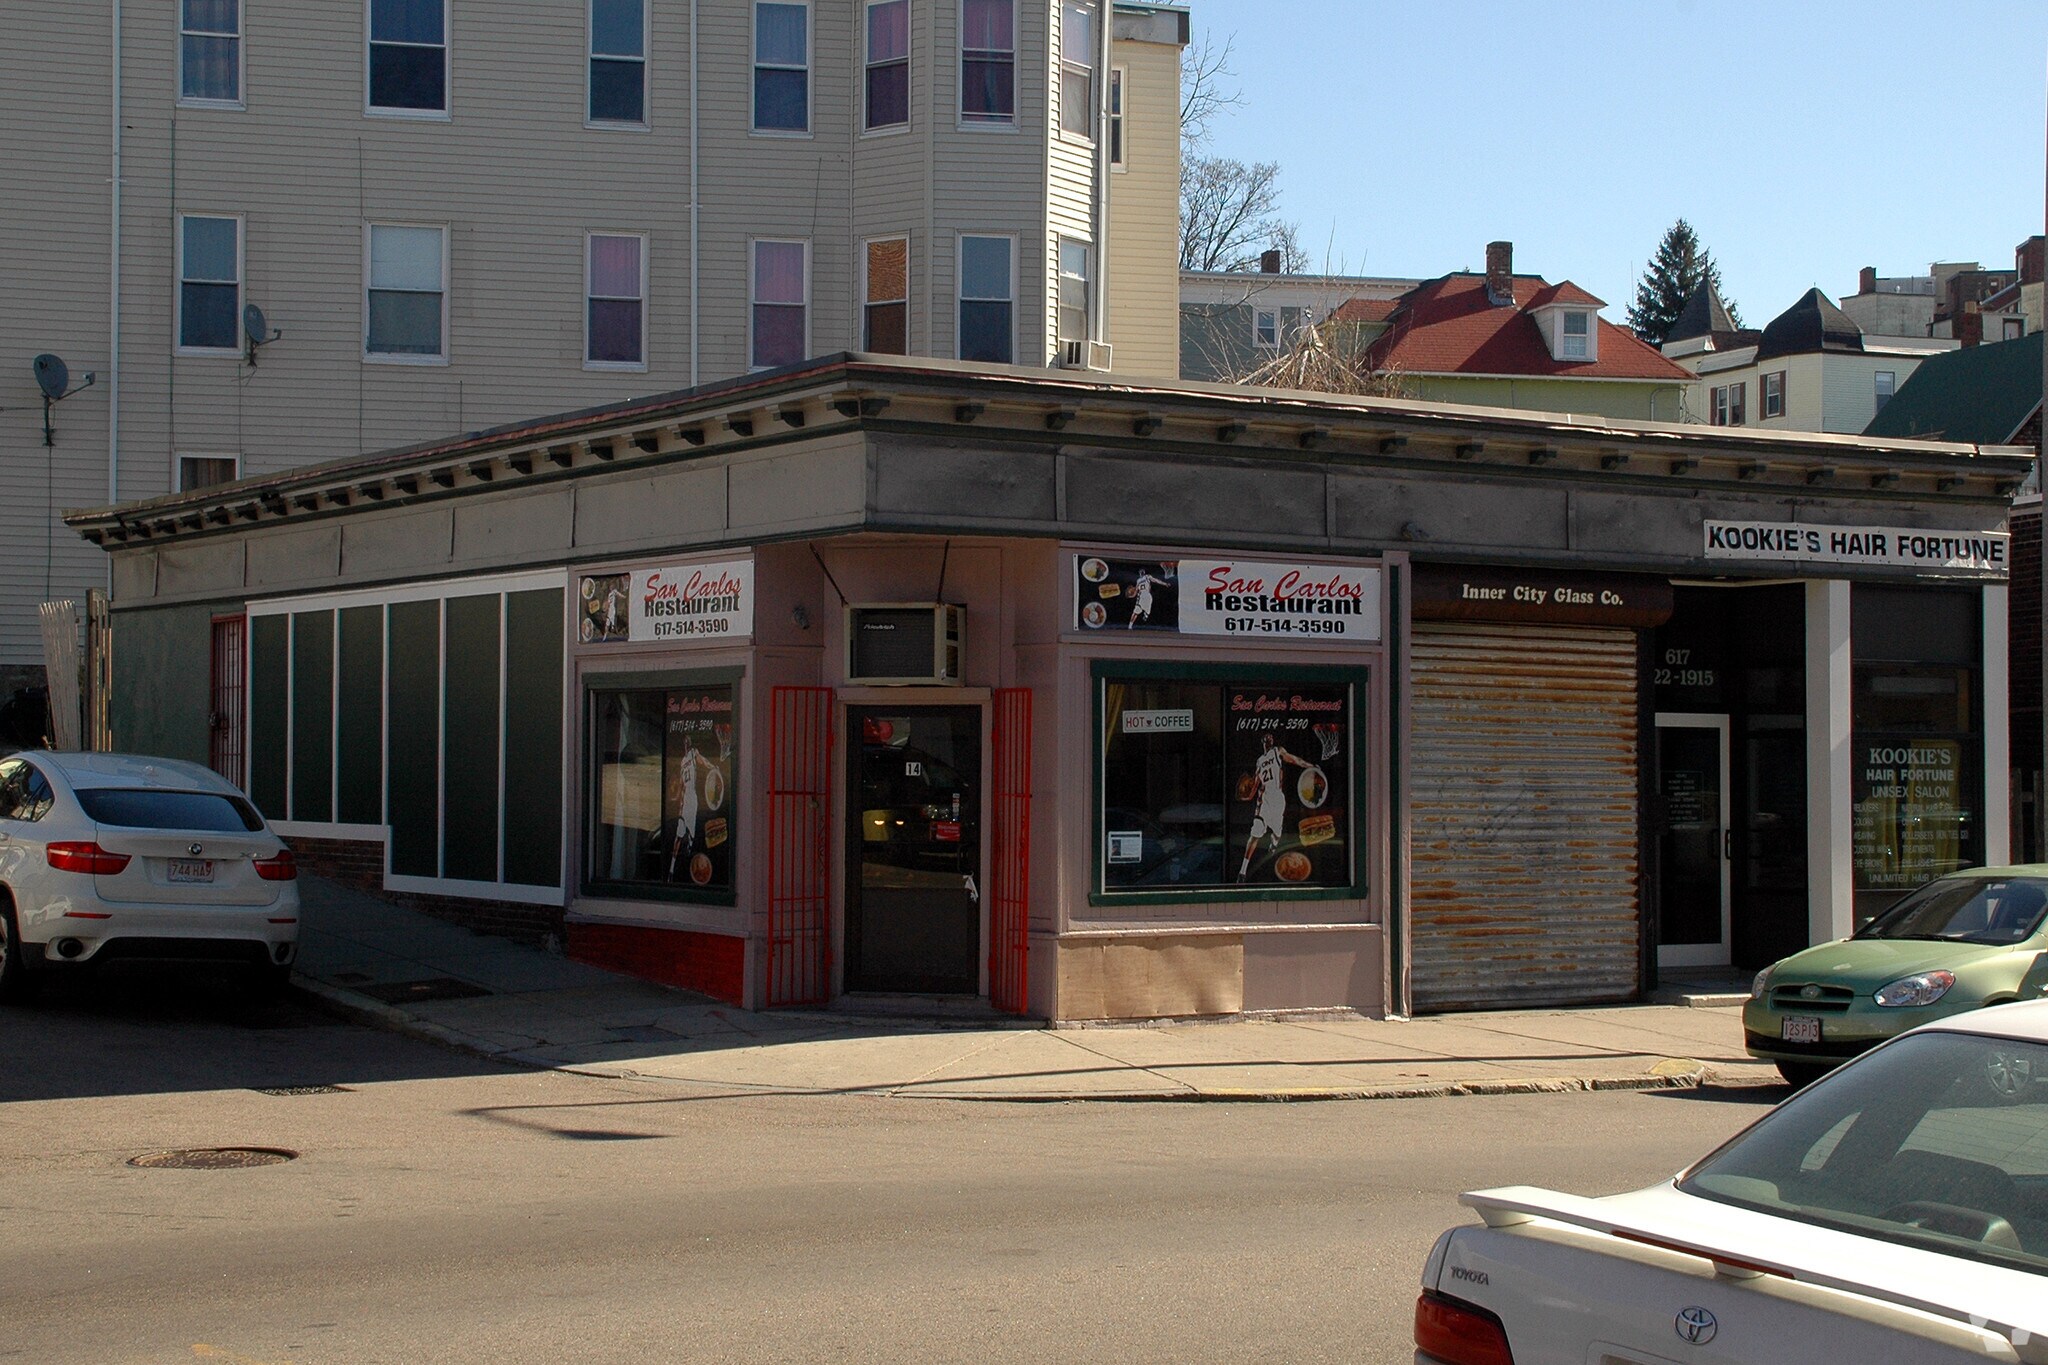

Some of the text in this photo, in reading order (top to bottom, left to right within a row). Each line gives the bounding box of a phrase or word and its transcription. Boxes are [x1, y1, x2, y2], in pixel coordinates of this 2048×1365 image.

[1708, 526, 2004, 562] KOOKIE'S HAIR FORTUNE
[644, 570, 742, 603] San Carlos
[1204, 566, 1365, 601] San Carlos
[1462, 583, 1624, 606] Inner City Glass Co.
[644, 593, 741, 618] Restaurant
[1204, 592, 1363, 616] Restaurant
[654, 617, 730, 636] 617-514-3590
[1224, 617, 1346, 635] 617-514-3590
[1665, 648, 1691, 665] 617
[1653, 668, 1714, 686] 22-1915
[1231, 694, 1344, 713] San Carlos Restaurant
[1125, 715, 1191, 730] HOT COFFEE
[1869, 748, 1952, 765] KOOKIE'S
[908, 763, 920, 775] 14
[1262, 768, 1274, 782] 21
[1866, 769, 1955, 781] HAIR FORTUNE
[1872, 786, 1950, 798] UNISEX SALON
[172, 863, 191, 876] 744
[1869, 873, 1908, 883] UNLIMITED
[1911, 873, 1930, 883] HAIR
[1450, 1266, 1489, 1285] TOYOTA
